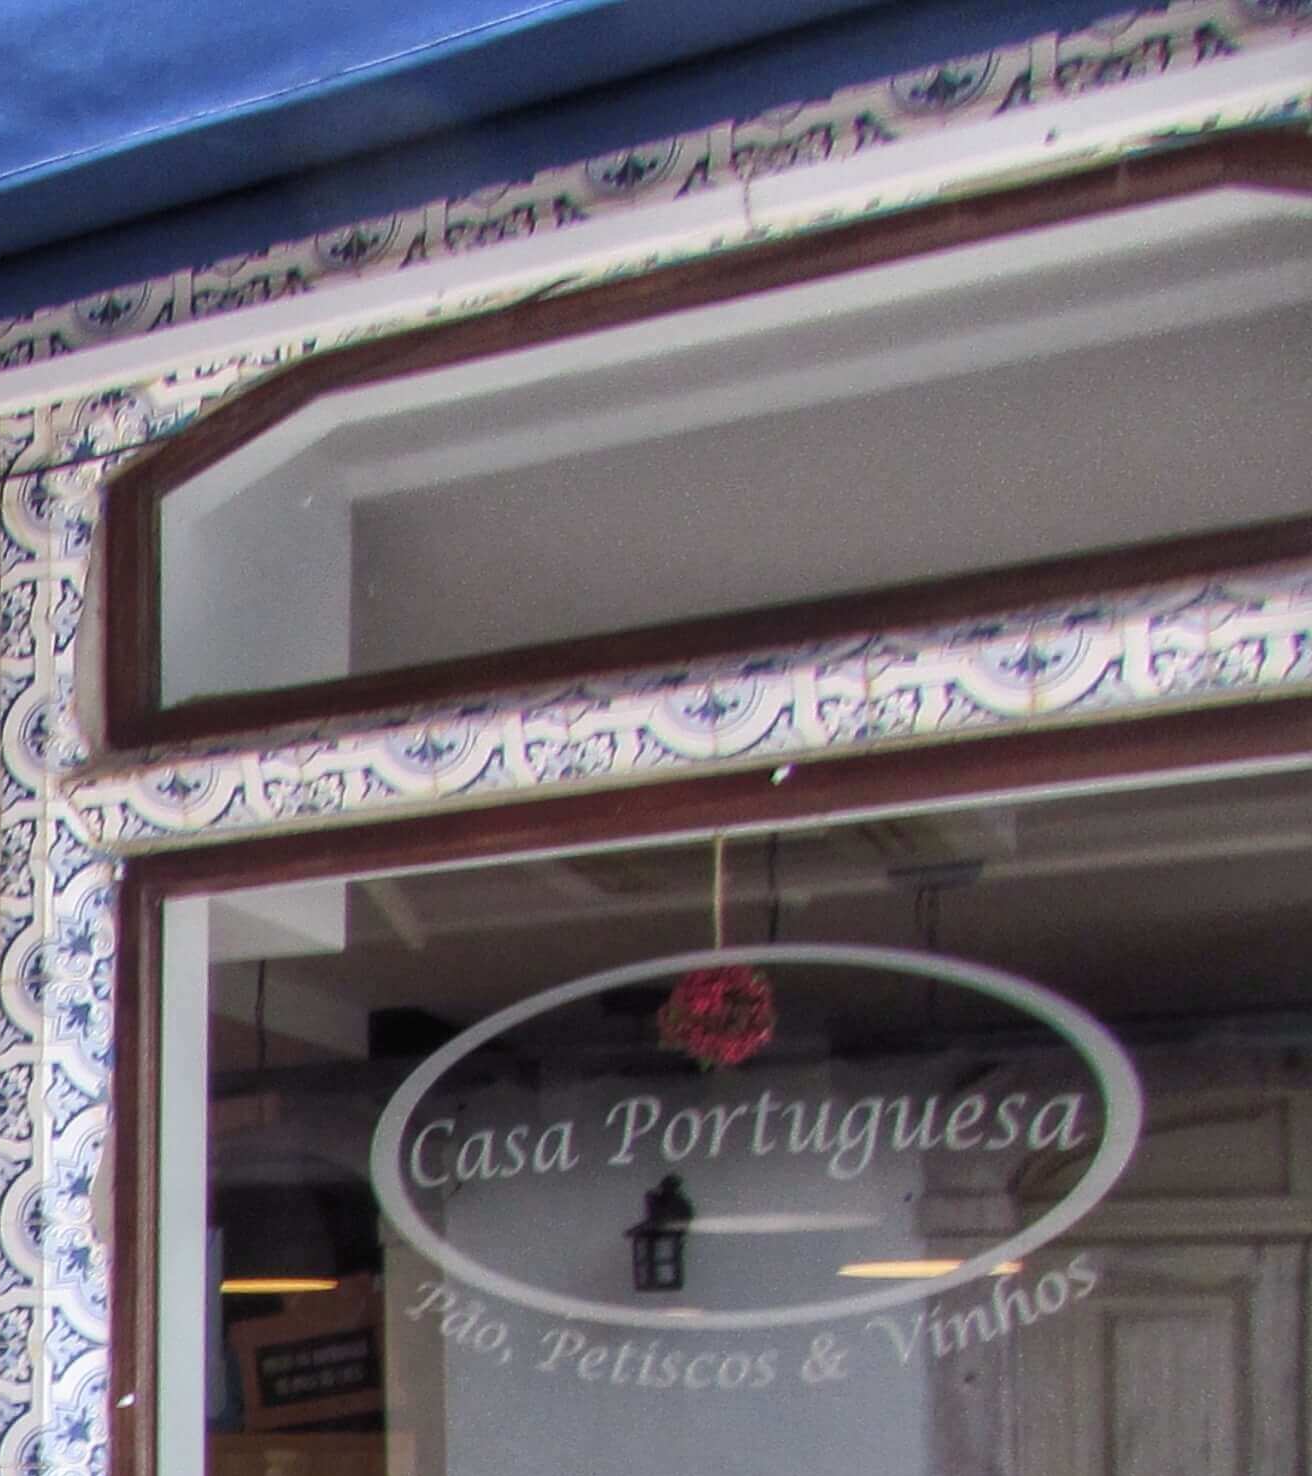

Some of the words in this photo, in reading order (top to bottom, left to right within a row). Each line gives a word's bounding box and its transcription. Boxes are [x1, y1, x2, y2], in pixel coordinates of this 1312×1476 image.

[409, 1118, 578, 1190] Casa
[606, 1091, 1088, 1181] Portuguesa
[538, 1321, 776, 1391] Petiscos
[799, 1329, 849, 1385] &
[866, 1249, 1100, 1368] Vinhos
